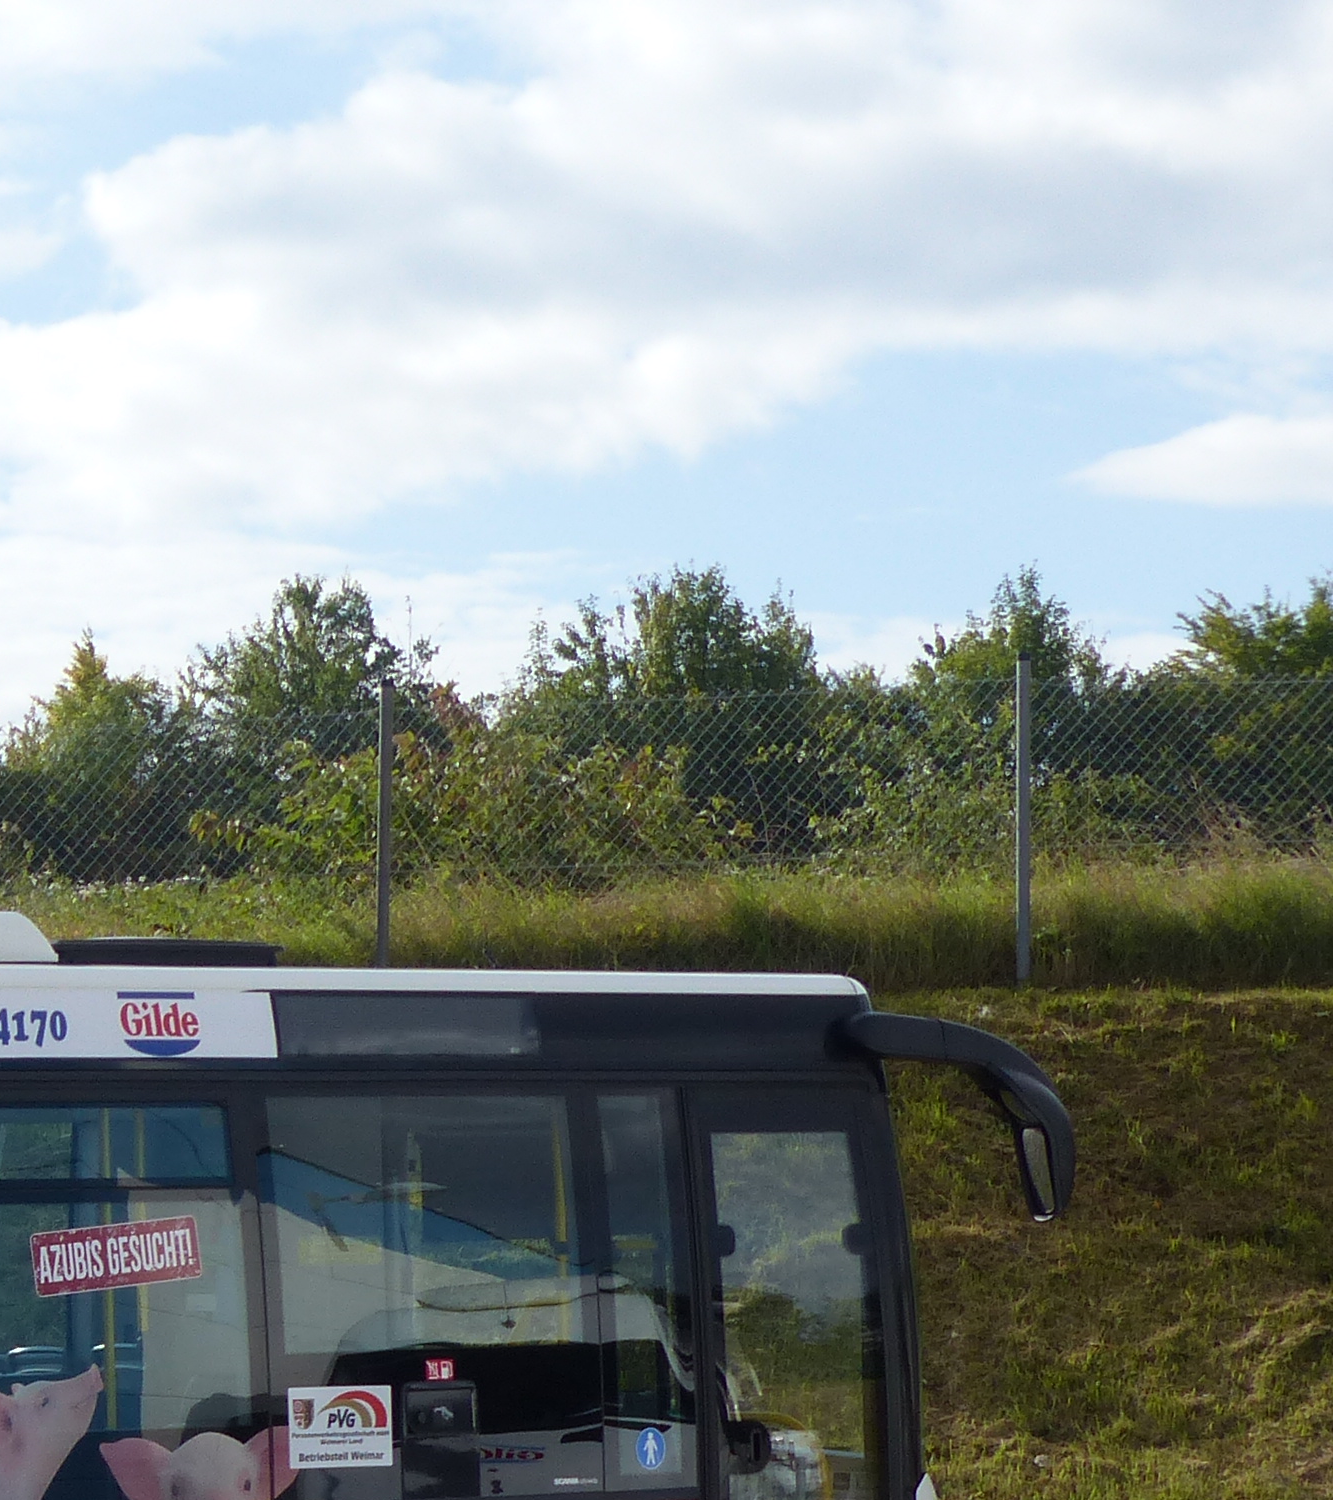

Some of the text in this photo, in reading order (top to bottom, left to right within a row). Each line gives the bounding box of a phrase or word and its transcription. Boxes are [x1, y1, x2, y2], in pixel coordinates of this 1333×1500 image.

[119, 1000, 200, 1038] Gilde
[39, 1228, 195, 1284] AZUBIS GESUCHT!
[326, 1408, 356, 1428] PVG
[298, 1451, 384, 1463] Betriebsteil Weimar
